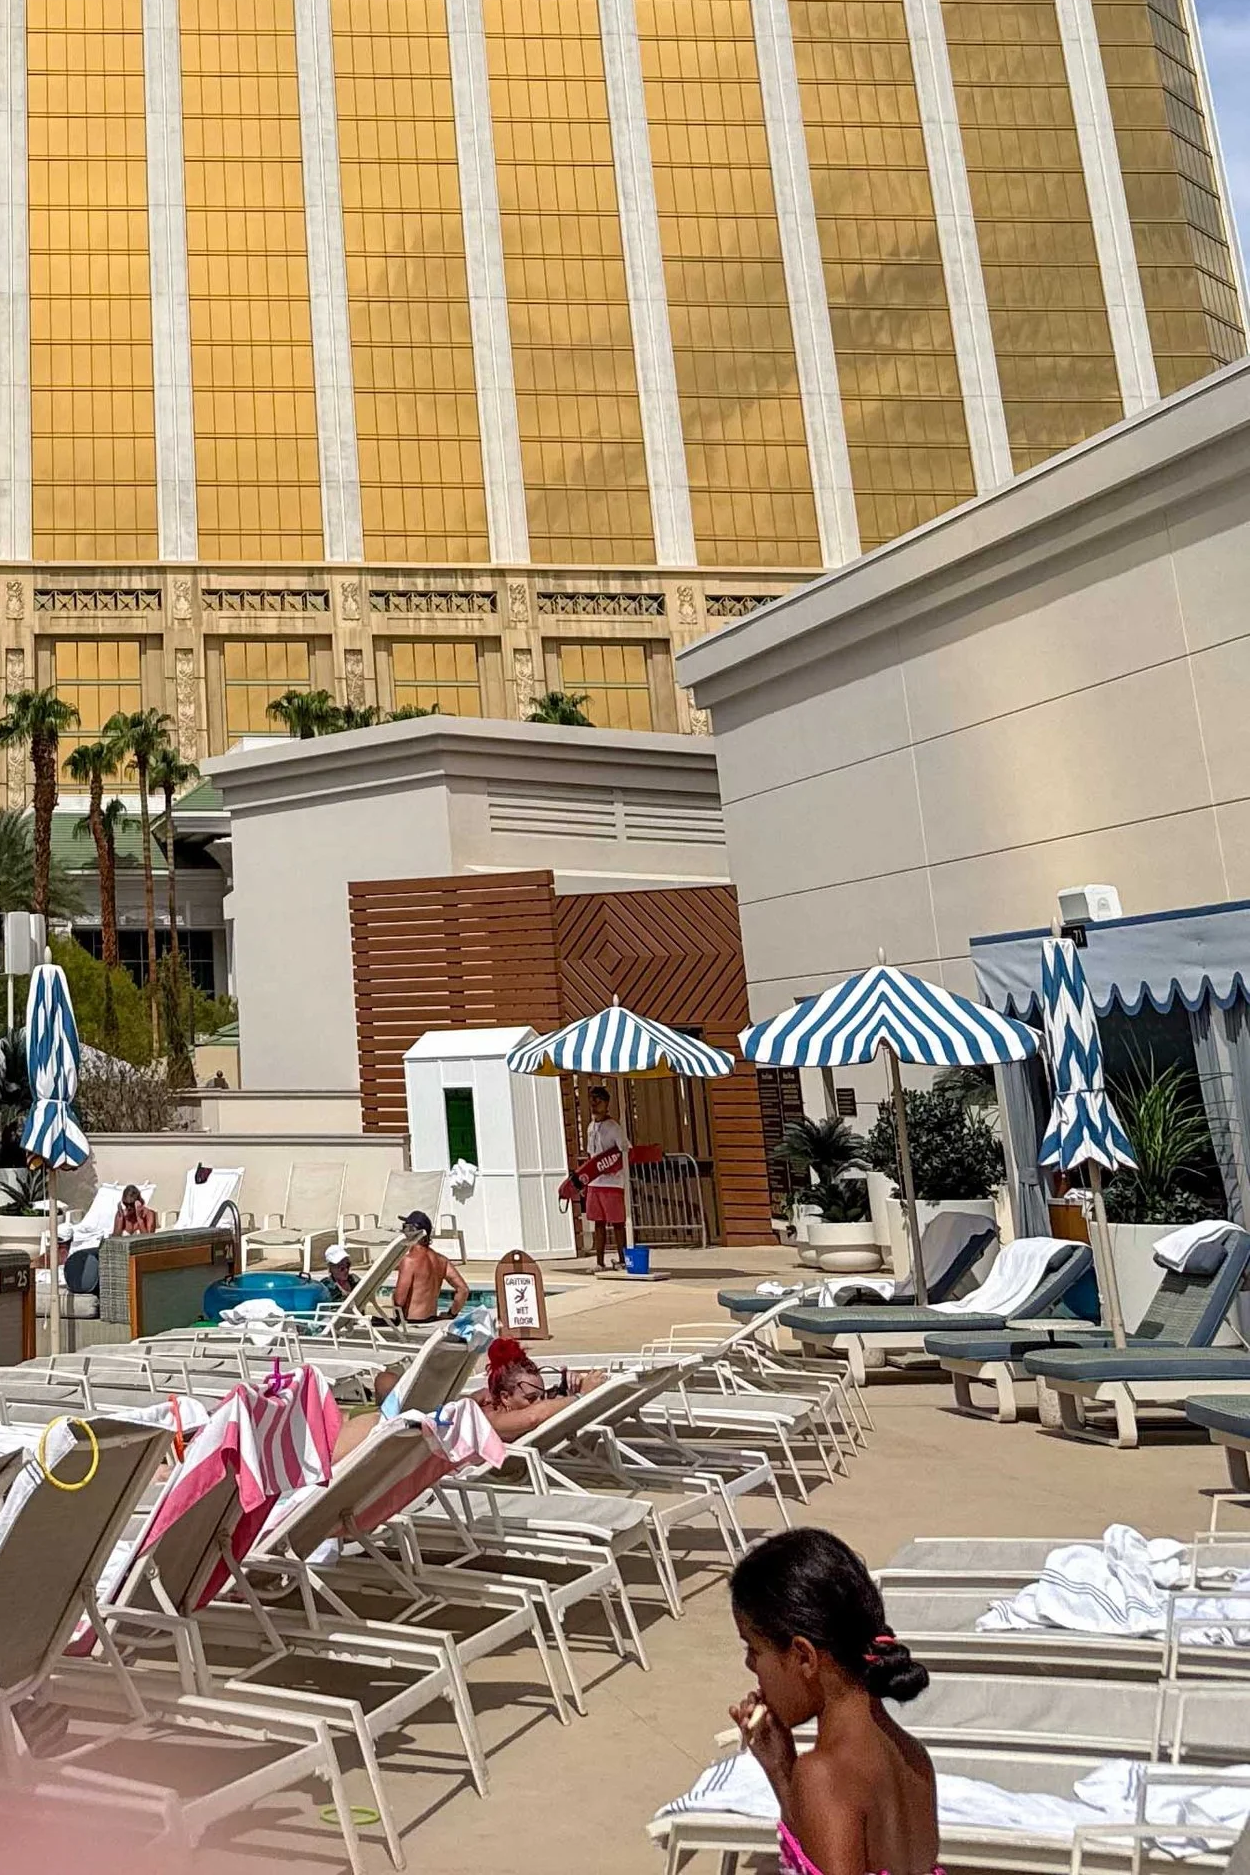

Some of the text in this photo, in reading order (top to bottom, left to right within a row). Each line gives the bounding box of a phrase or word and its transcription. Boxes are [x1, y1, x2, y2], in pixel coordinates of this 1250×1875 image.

[17, 1270, 28, 1287] 25
[516, 1306, 529, 1315] WET
[513, 1316, 533, 1325] FLOOR
